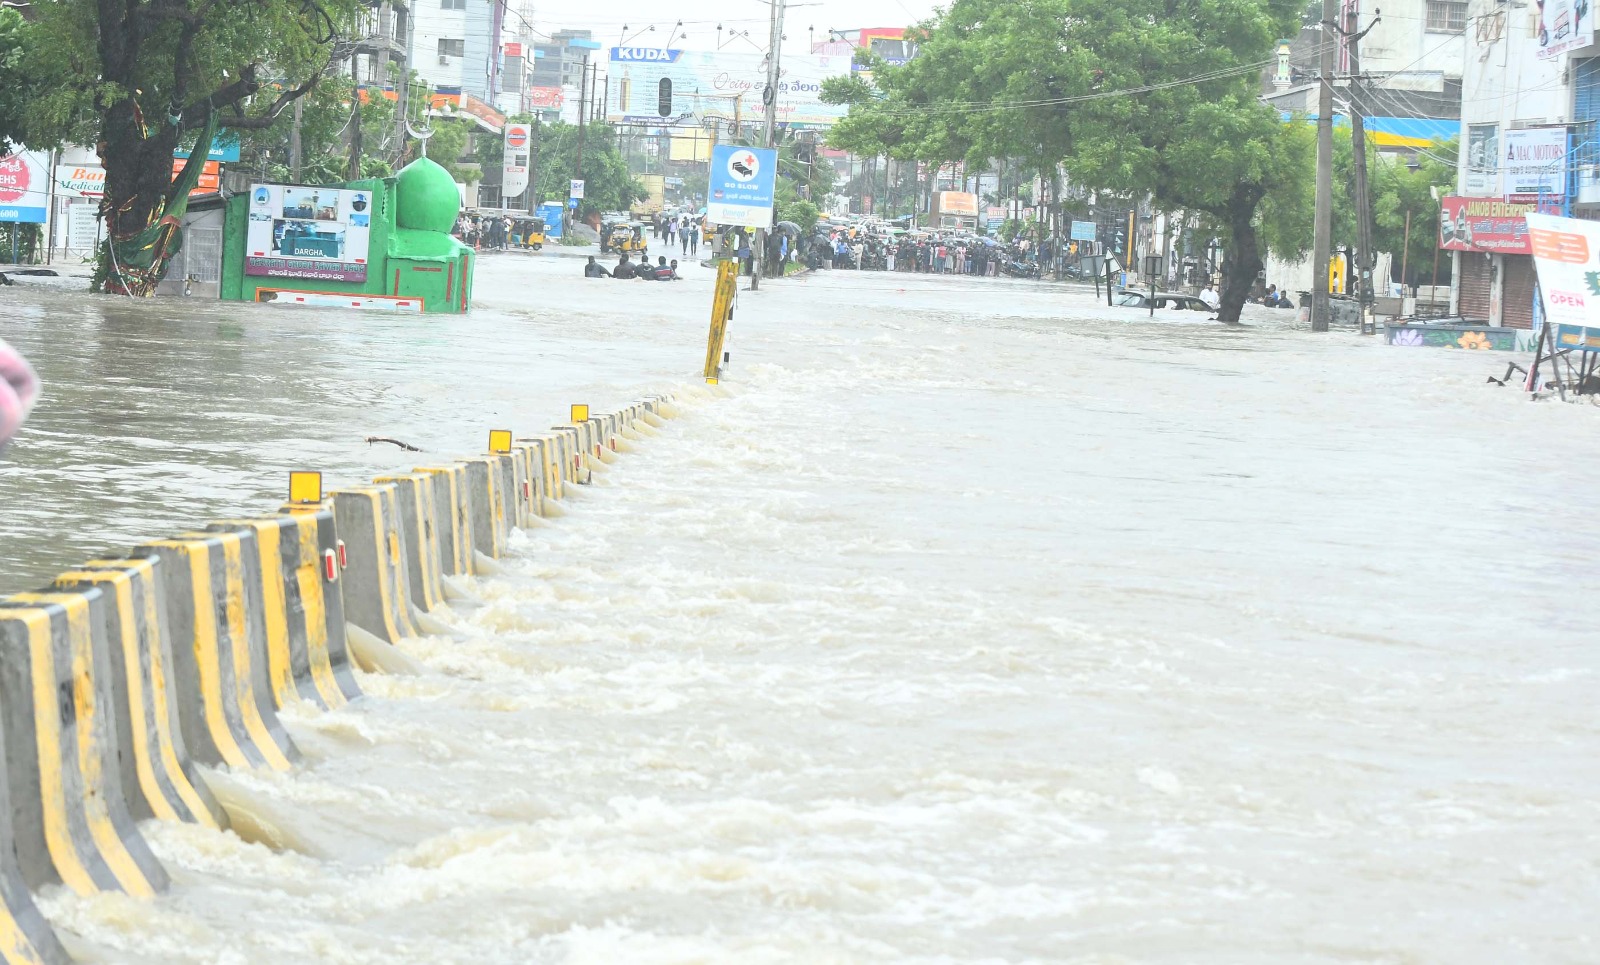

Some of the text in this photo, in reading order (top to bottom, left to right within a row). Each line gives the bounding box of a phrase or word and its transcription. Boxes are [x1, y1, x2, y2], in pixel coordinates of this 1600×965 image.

[618, 47, 671, 61] KUDA
[713, 72, 753, 90] O'city
[1516, 144, 1564, 160] MAC MOTORS
[60, 180, 105, 191] Medical
[1466, 201, 1490, 217] JANOB
[294, 247, 324, 257] DARGHA
[1549, 294, 1585, 308] OPEN
